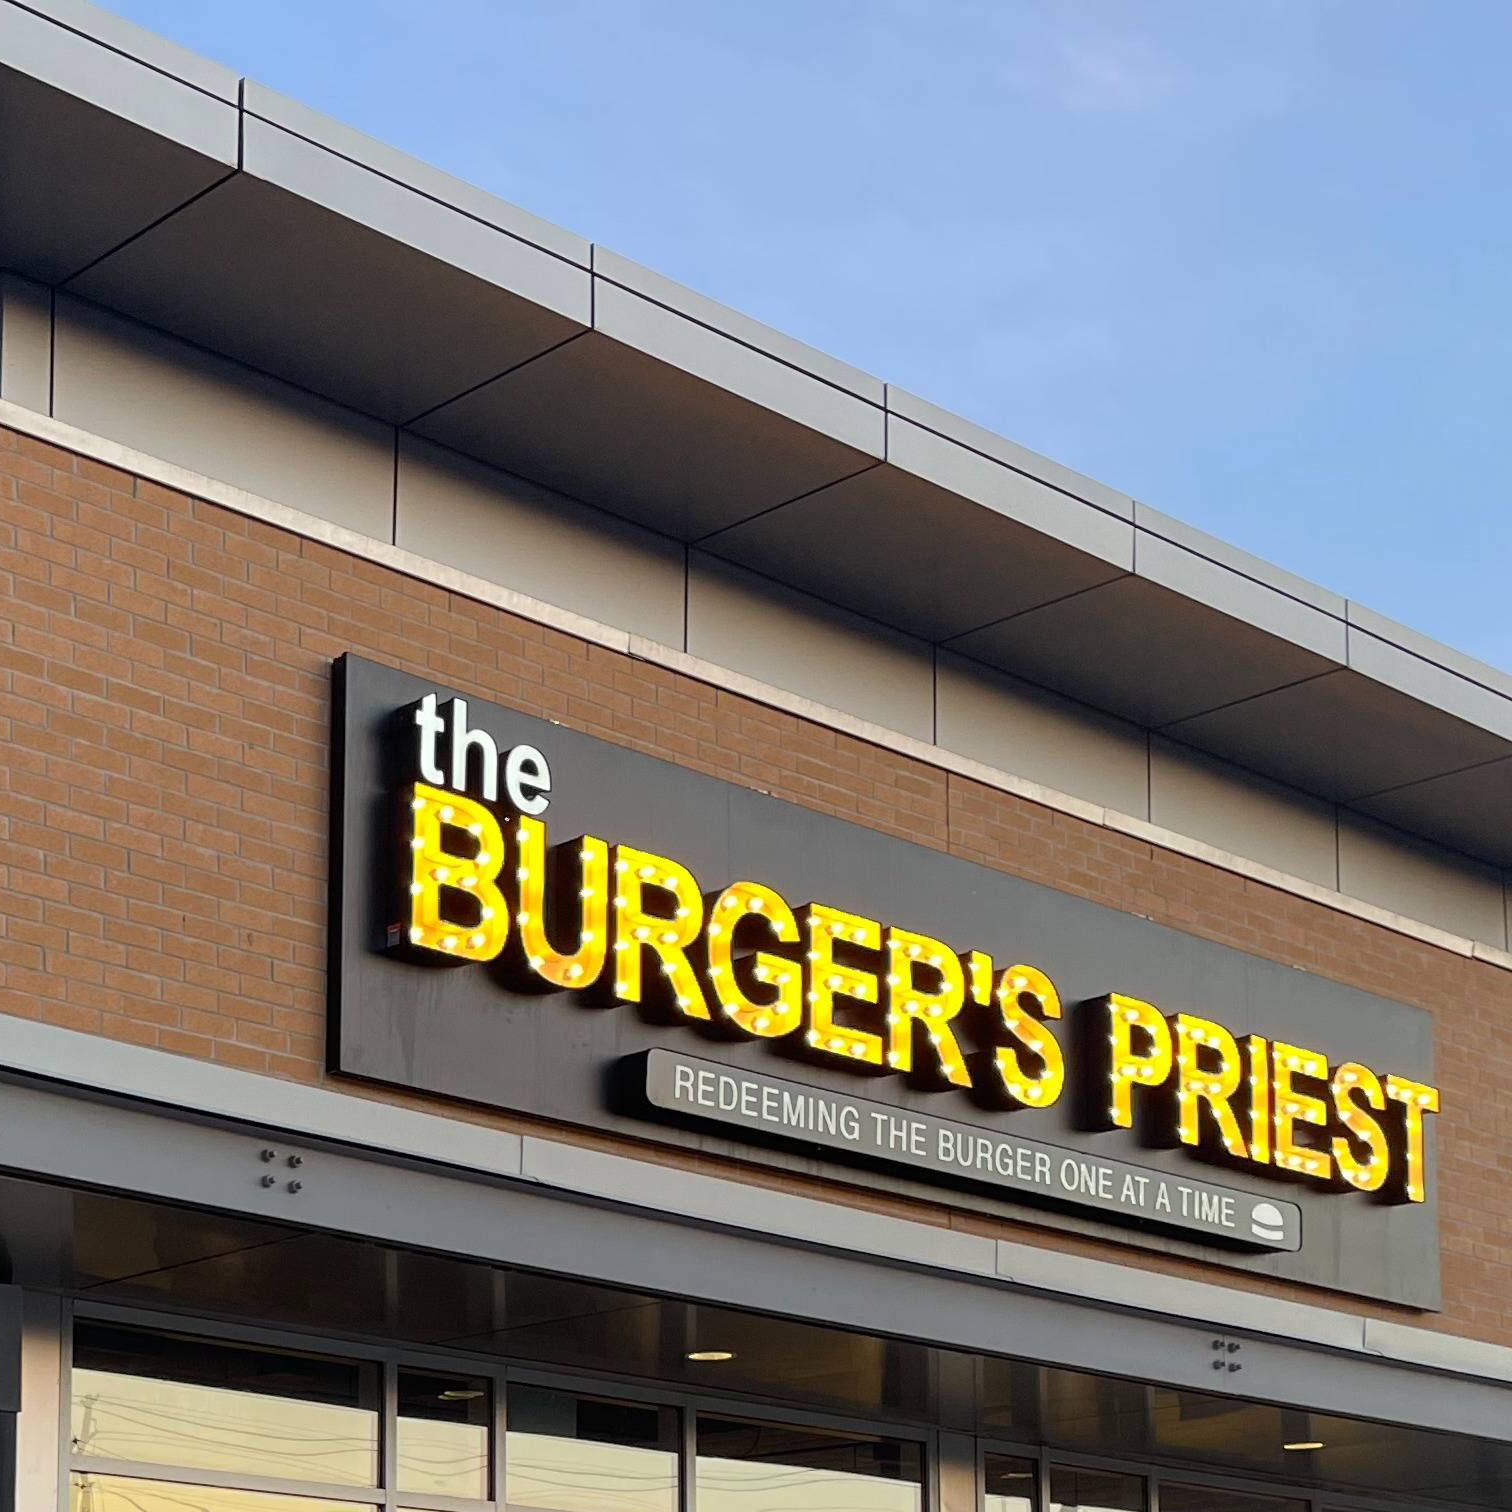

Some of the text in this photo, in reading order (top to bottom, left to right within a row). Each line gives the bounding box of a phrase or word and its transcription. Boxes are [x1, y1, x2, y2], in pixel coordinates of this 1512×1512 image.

[416, 693, 552, 815] the
[410, 781, 1440, 1203] BURGER'S PRIEST
[674, 1064, 1235, 1228] REDEEMING THE BURGER ONE AT A TIME
